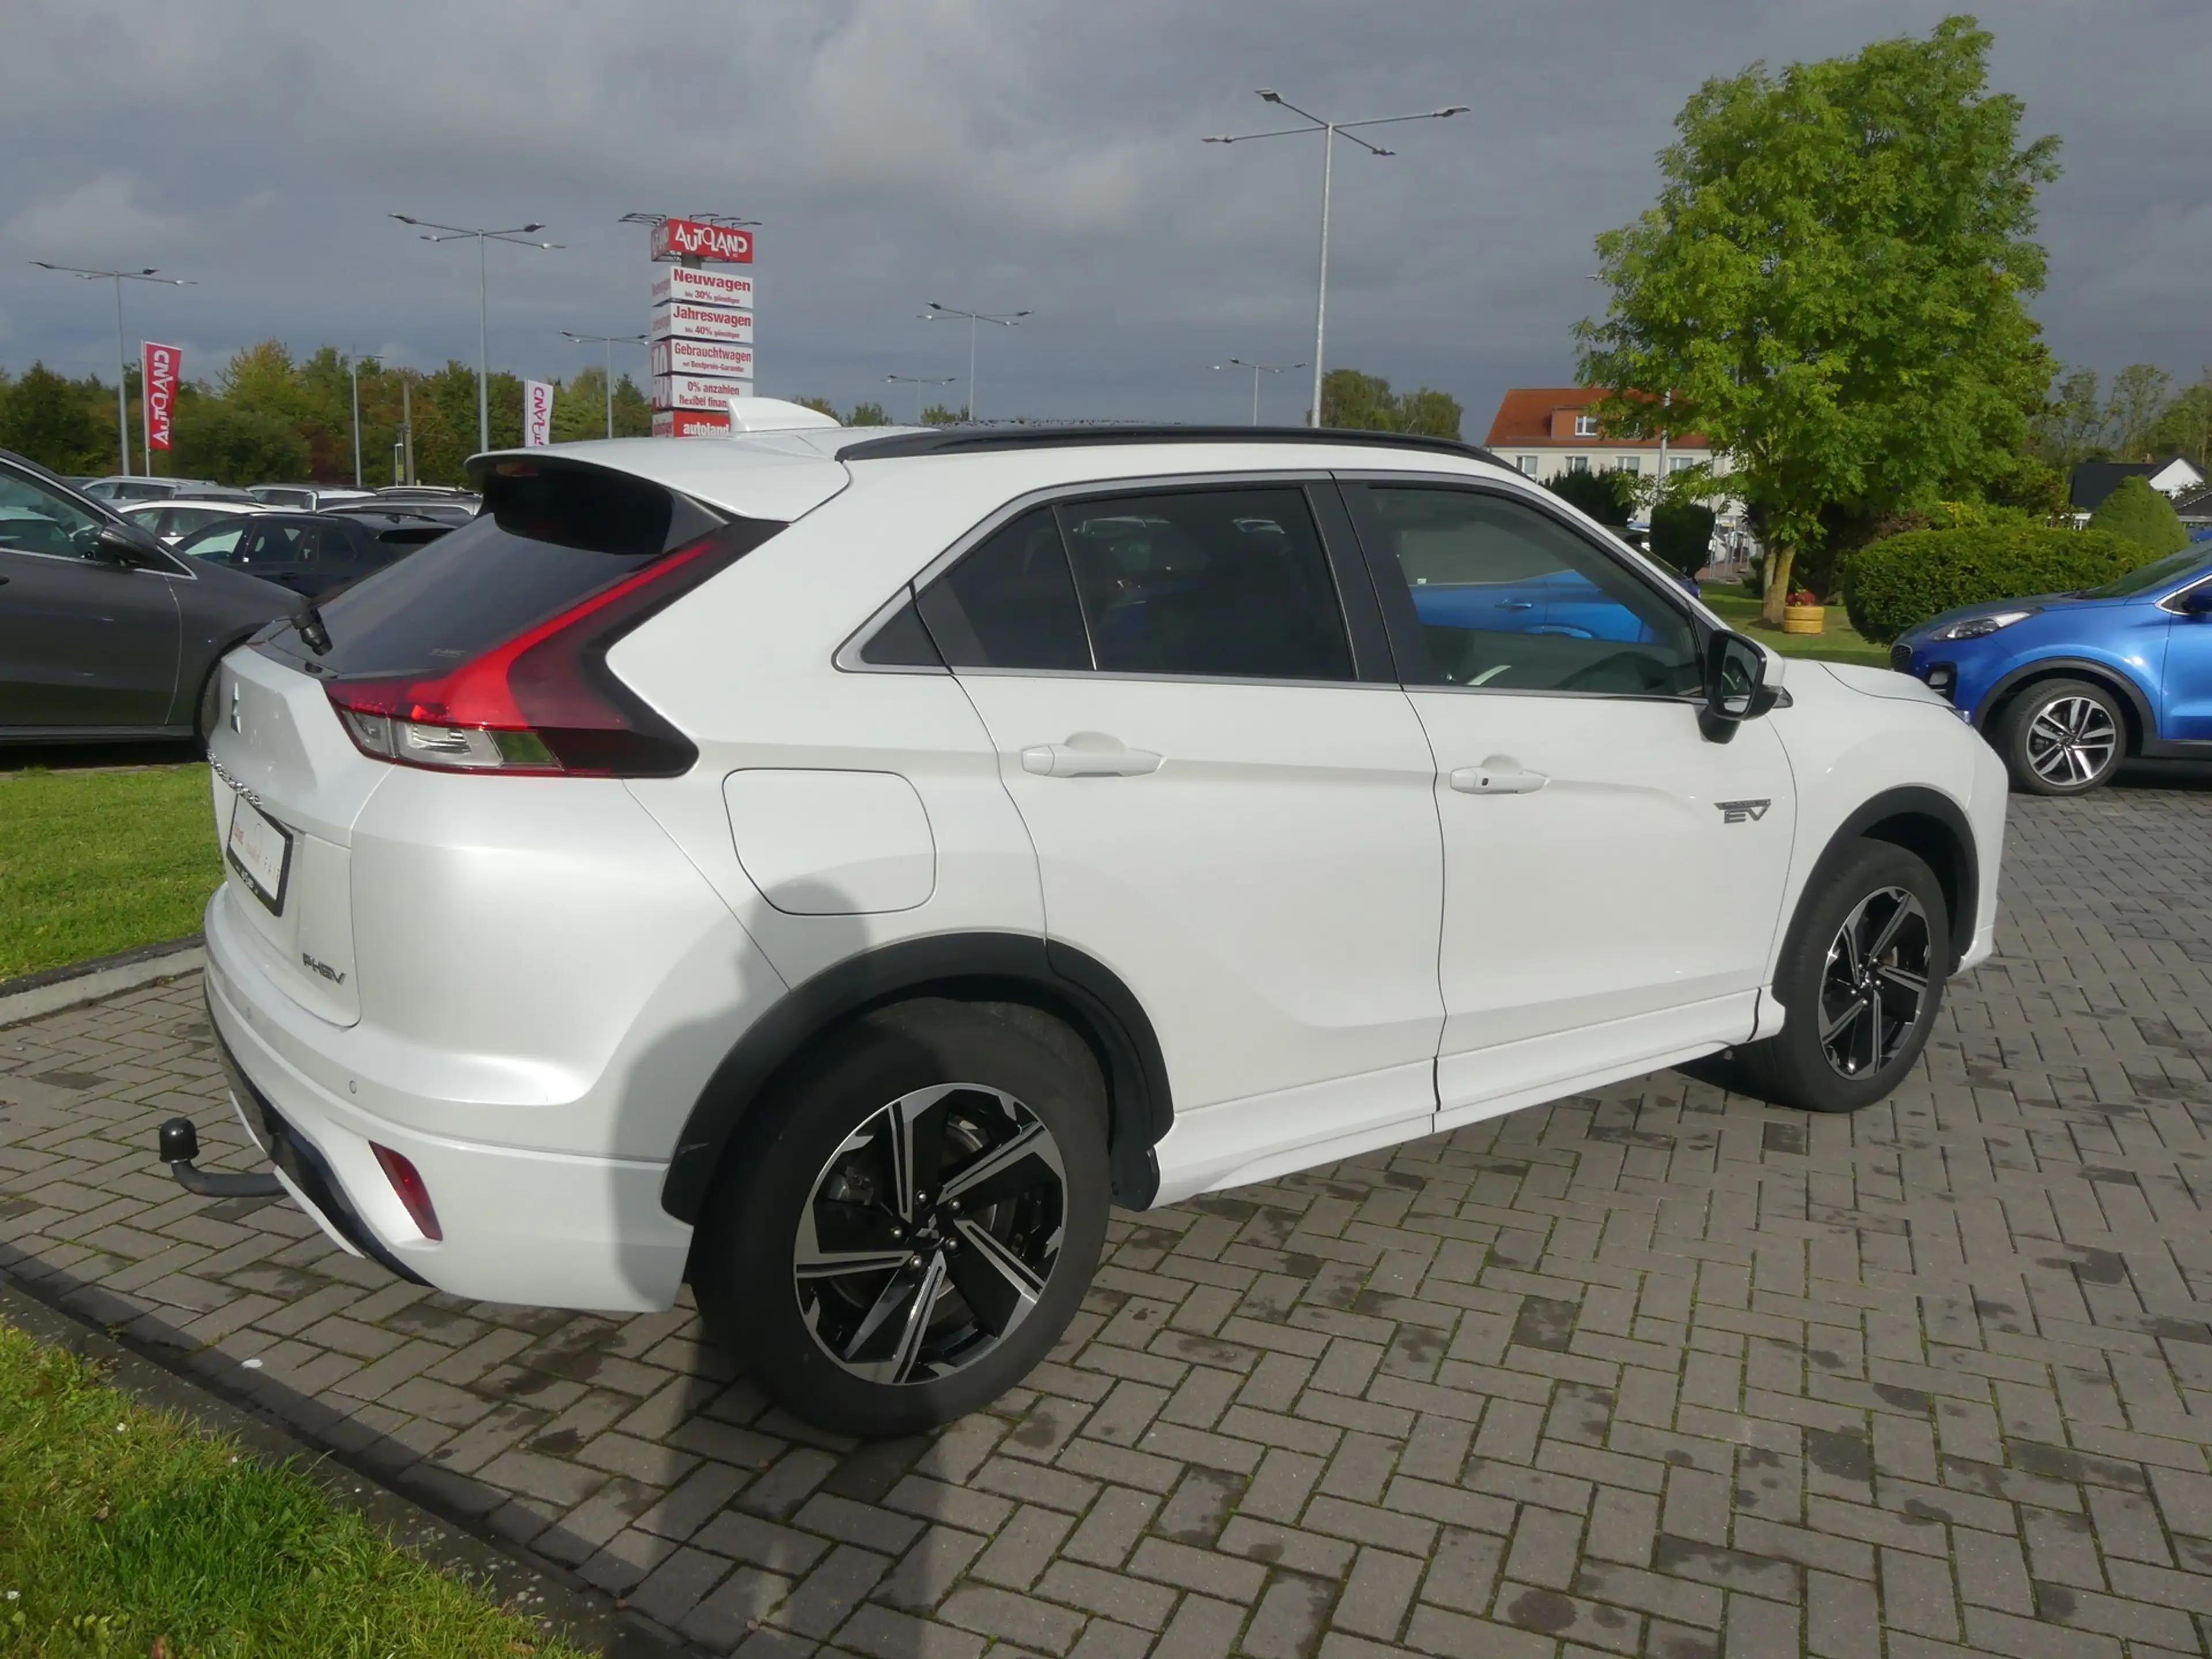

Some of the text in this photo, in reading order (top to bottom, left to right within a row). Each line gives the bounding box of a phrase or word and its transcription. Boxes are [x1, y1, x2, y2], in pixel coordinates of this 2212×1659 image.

[675, 223, 748, 257] AUTOLAND
[673, 268, 751, 292] Neuwagen
[695, 290, 713, 300] 30%
[673, 305, 751, 328] Jahreswagen
[695, 325, 713, 335] 40%
[675, 342, 751, 363] Gebrauchtwagen
[687, 381, 740, 396] 0% anzahlen
[679, 394, 706, 406] flexibel
[302, 952, 347, 986] PHEV
